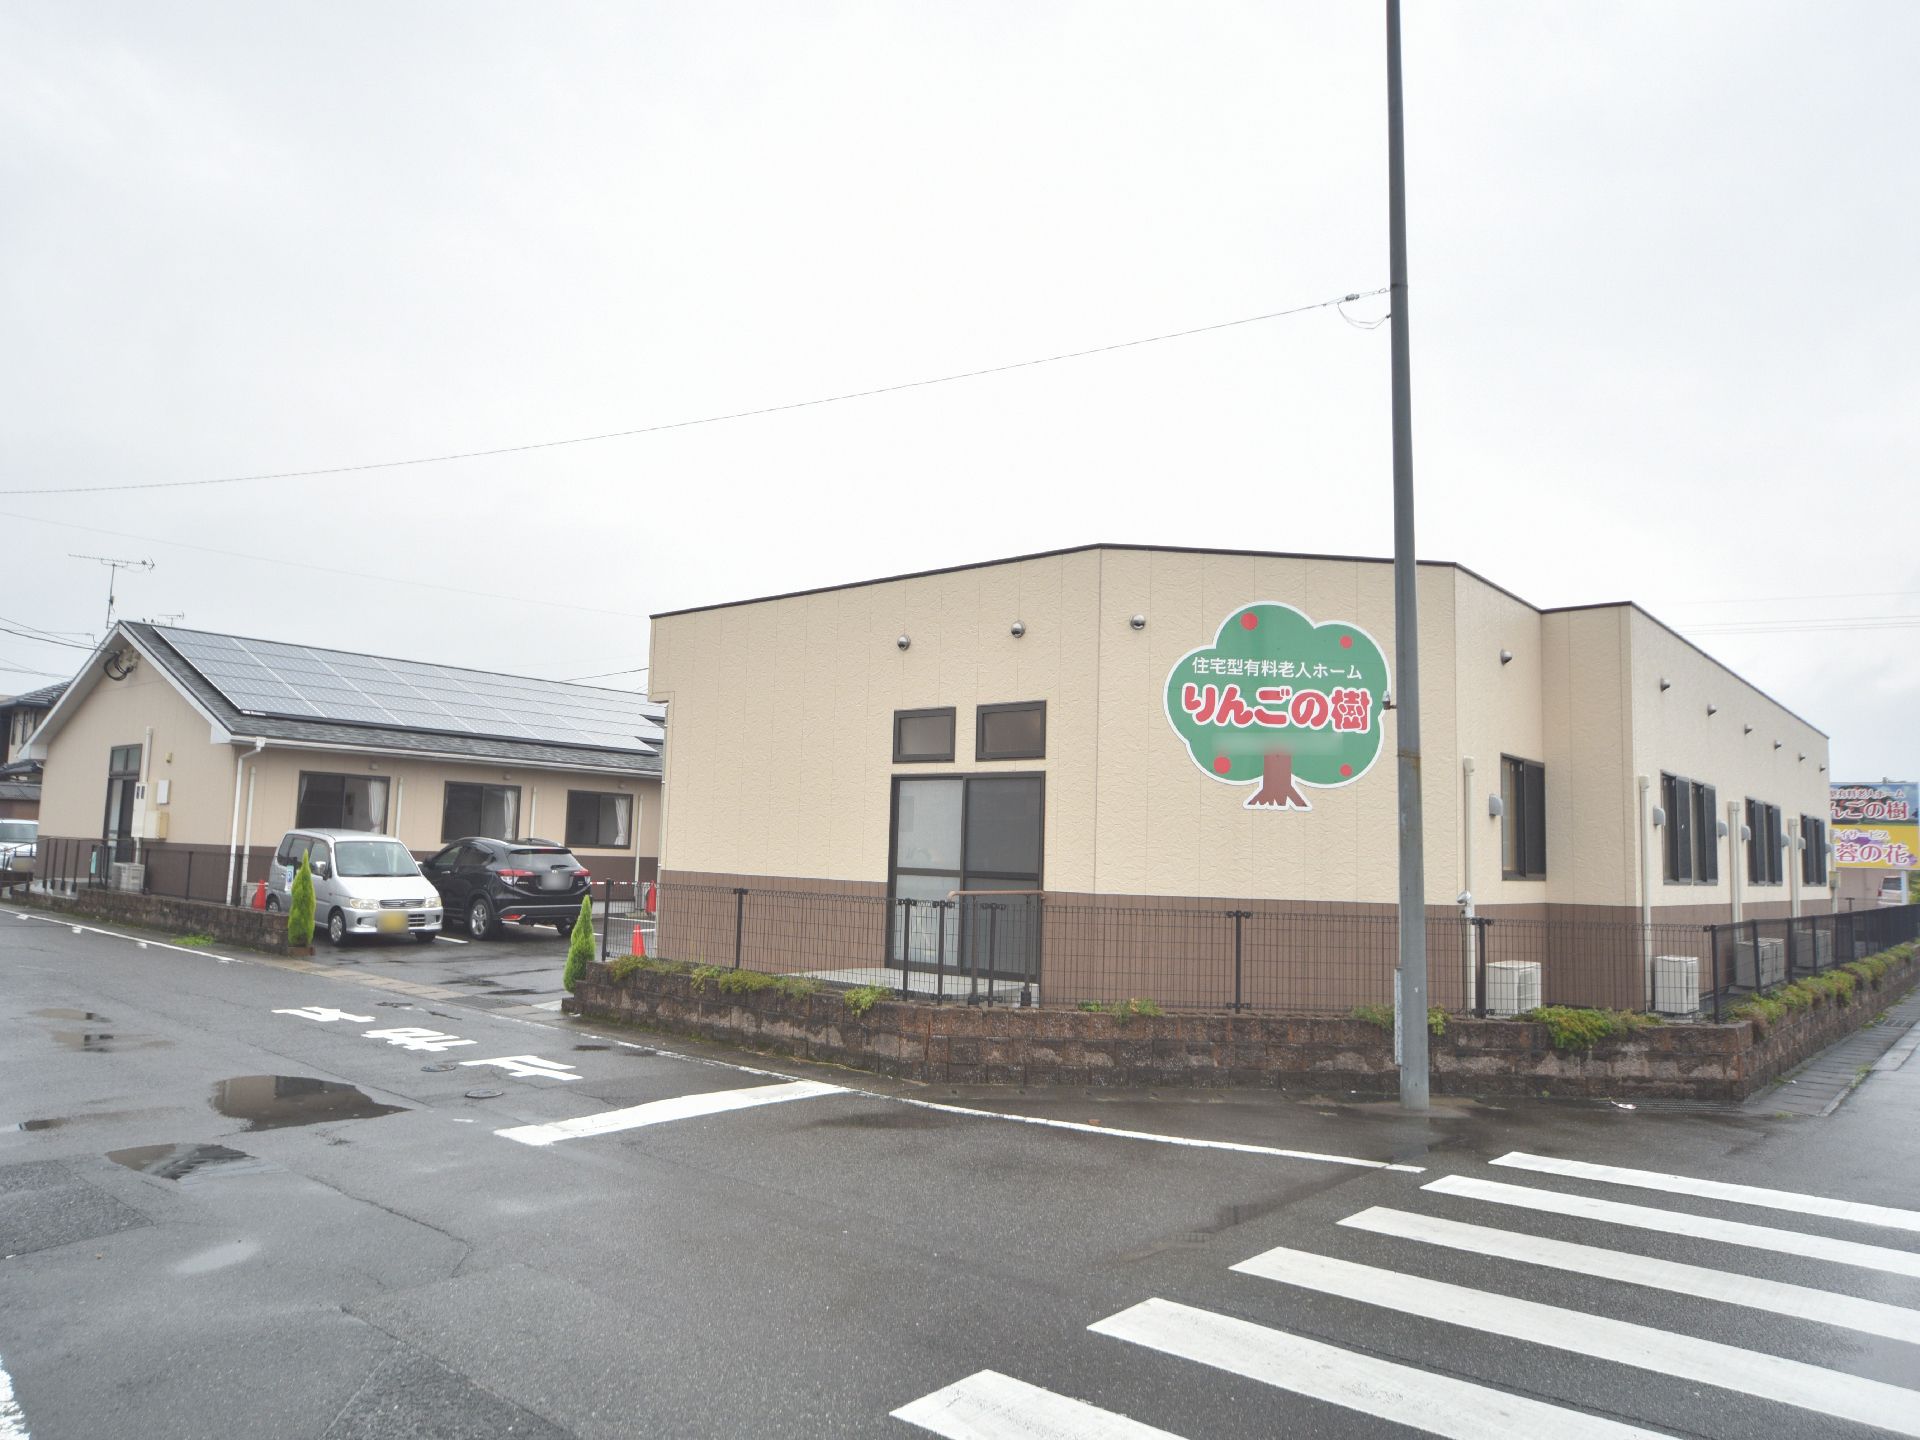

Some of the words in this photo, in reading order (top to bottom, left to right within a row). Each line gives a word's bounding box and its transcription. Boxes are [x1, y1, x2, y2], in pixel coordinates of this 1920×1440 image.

[1192, 656, 1363, 680] 住宅型有料老人ホーム
[1183, 684, 1371, 733] りんごの樹
